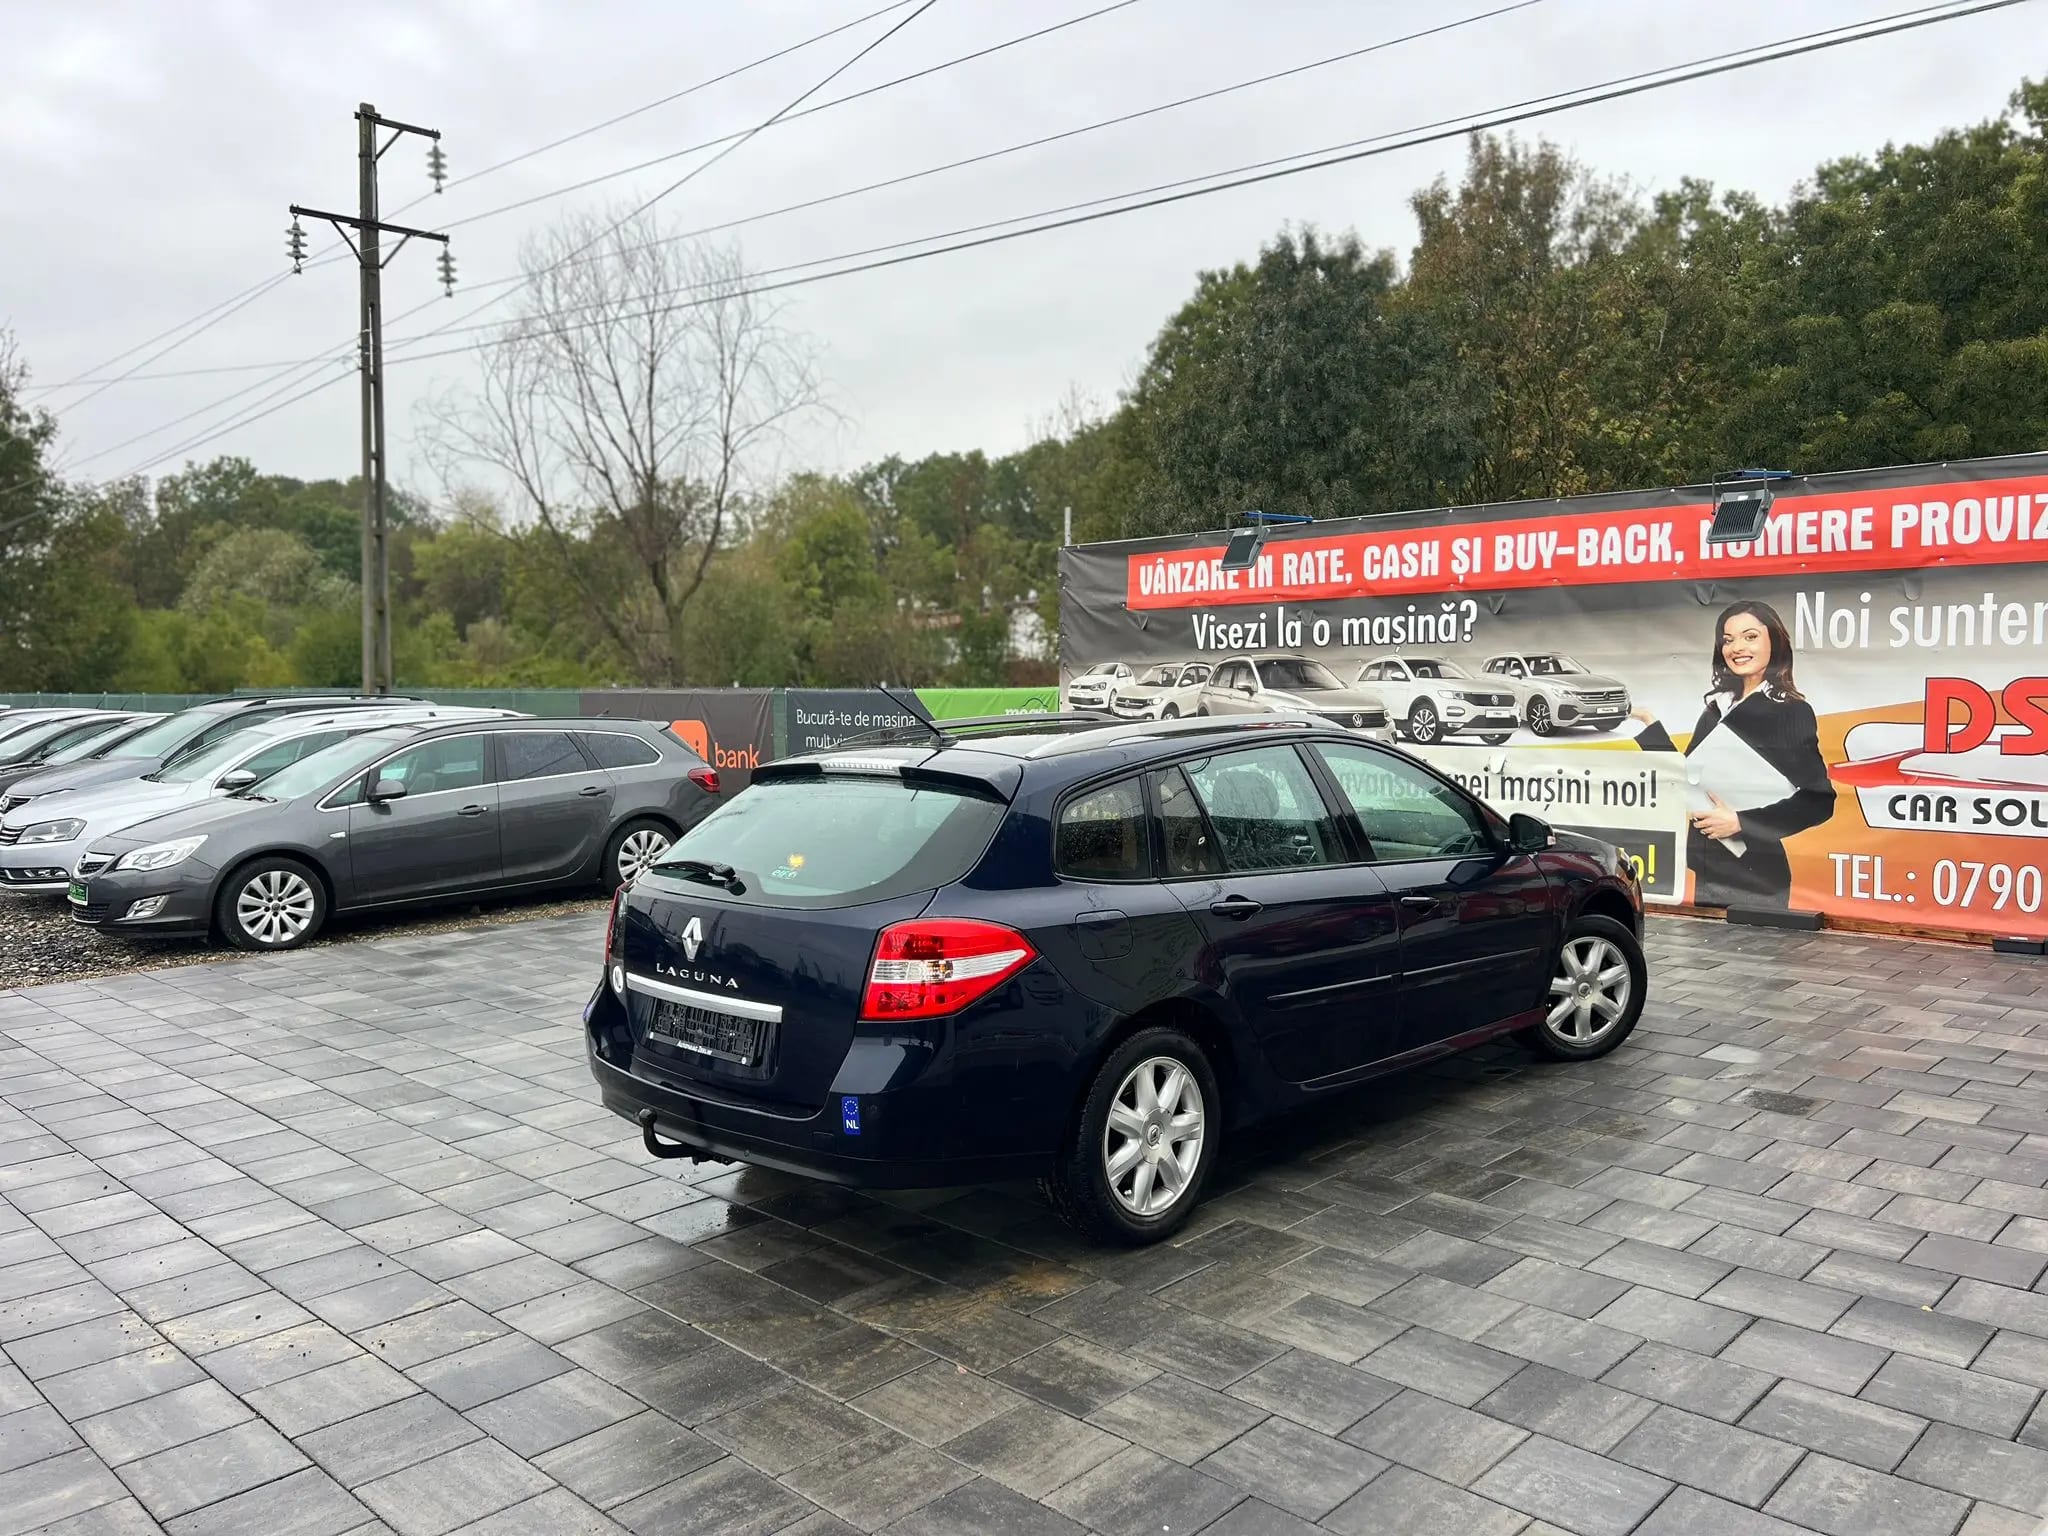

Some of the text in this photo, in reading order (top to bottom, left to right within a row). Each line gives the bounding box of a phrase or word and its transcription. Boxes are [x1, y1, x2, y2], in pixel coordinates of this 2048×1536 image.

[1139, 557, 1240, 597] VÂNZARE
[1283, 548, 1353, 587] RATE,
[1363, 540, 1440, 581] CASH
[1494, 521, 1685, 573] BUY-BACK,
[1191, 598, 1479, 654] Visezi la o mașină?
[1795, 590, 1873, 650] Noi
[796, 708, 851, 727] Bucură-te
[854, 710, 871, 727] de
[714, 741, 761, 769] bank
[1500, 767, 1591, 812] mașini
[1602, 769, 1658, 809] noi!
[1887, 793, 1957, 824] CAR
[1932, 858, 2043, 914] 0790
[656, 962, 739, 989] LAGUNA
[845, 1119, 860, 1130] NL
